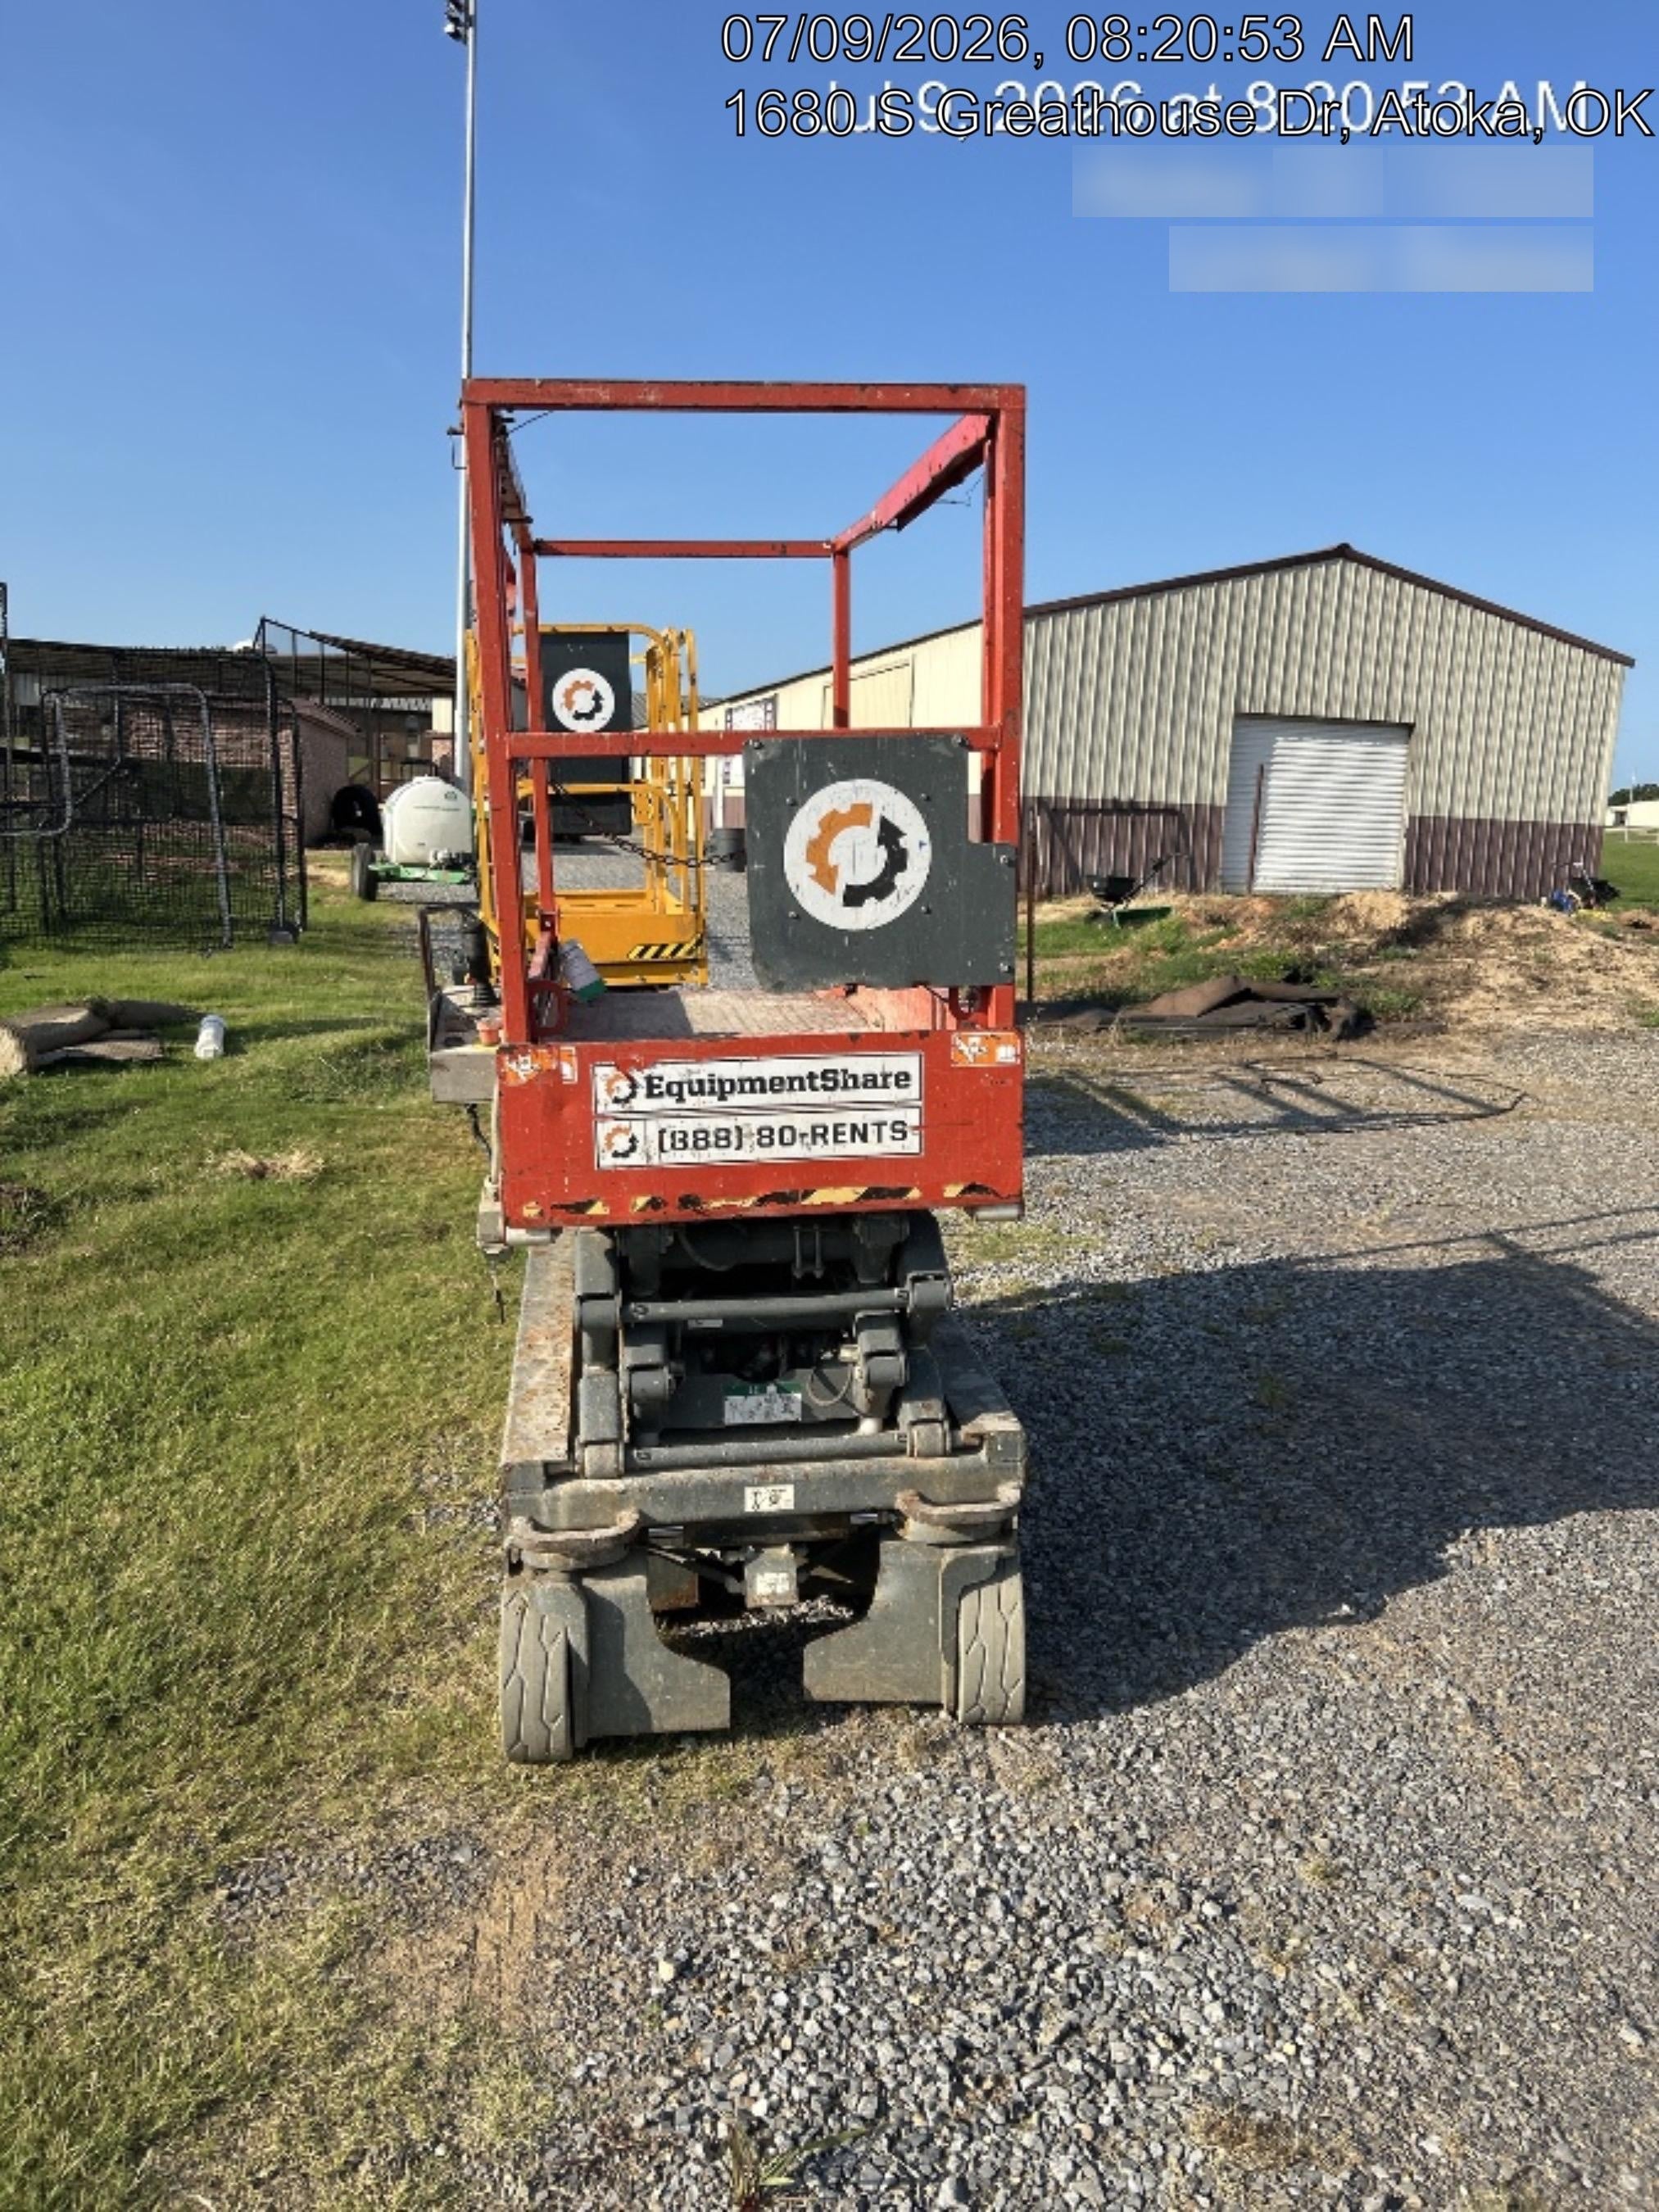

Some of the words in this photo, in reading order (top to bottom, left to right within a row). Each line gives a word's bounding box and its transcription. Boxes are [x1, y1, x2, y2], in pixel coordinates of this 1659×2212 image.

[644, 1067, 911, 1104] EquipmentShare
[658, 1124, 743, 1153] (888)
[756, 1120, 909, 1148] 80-RENTS
